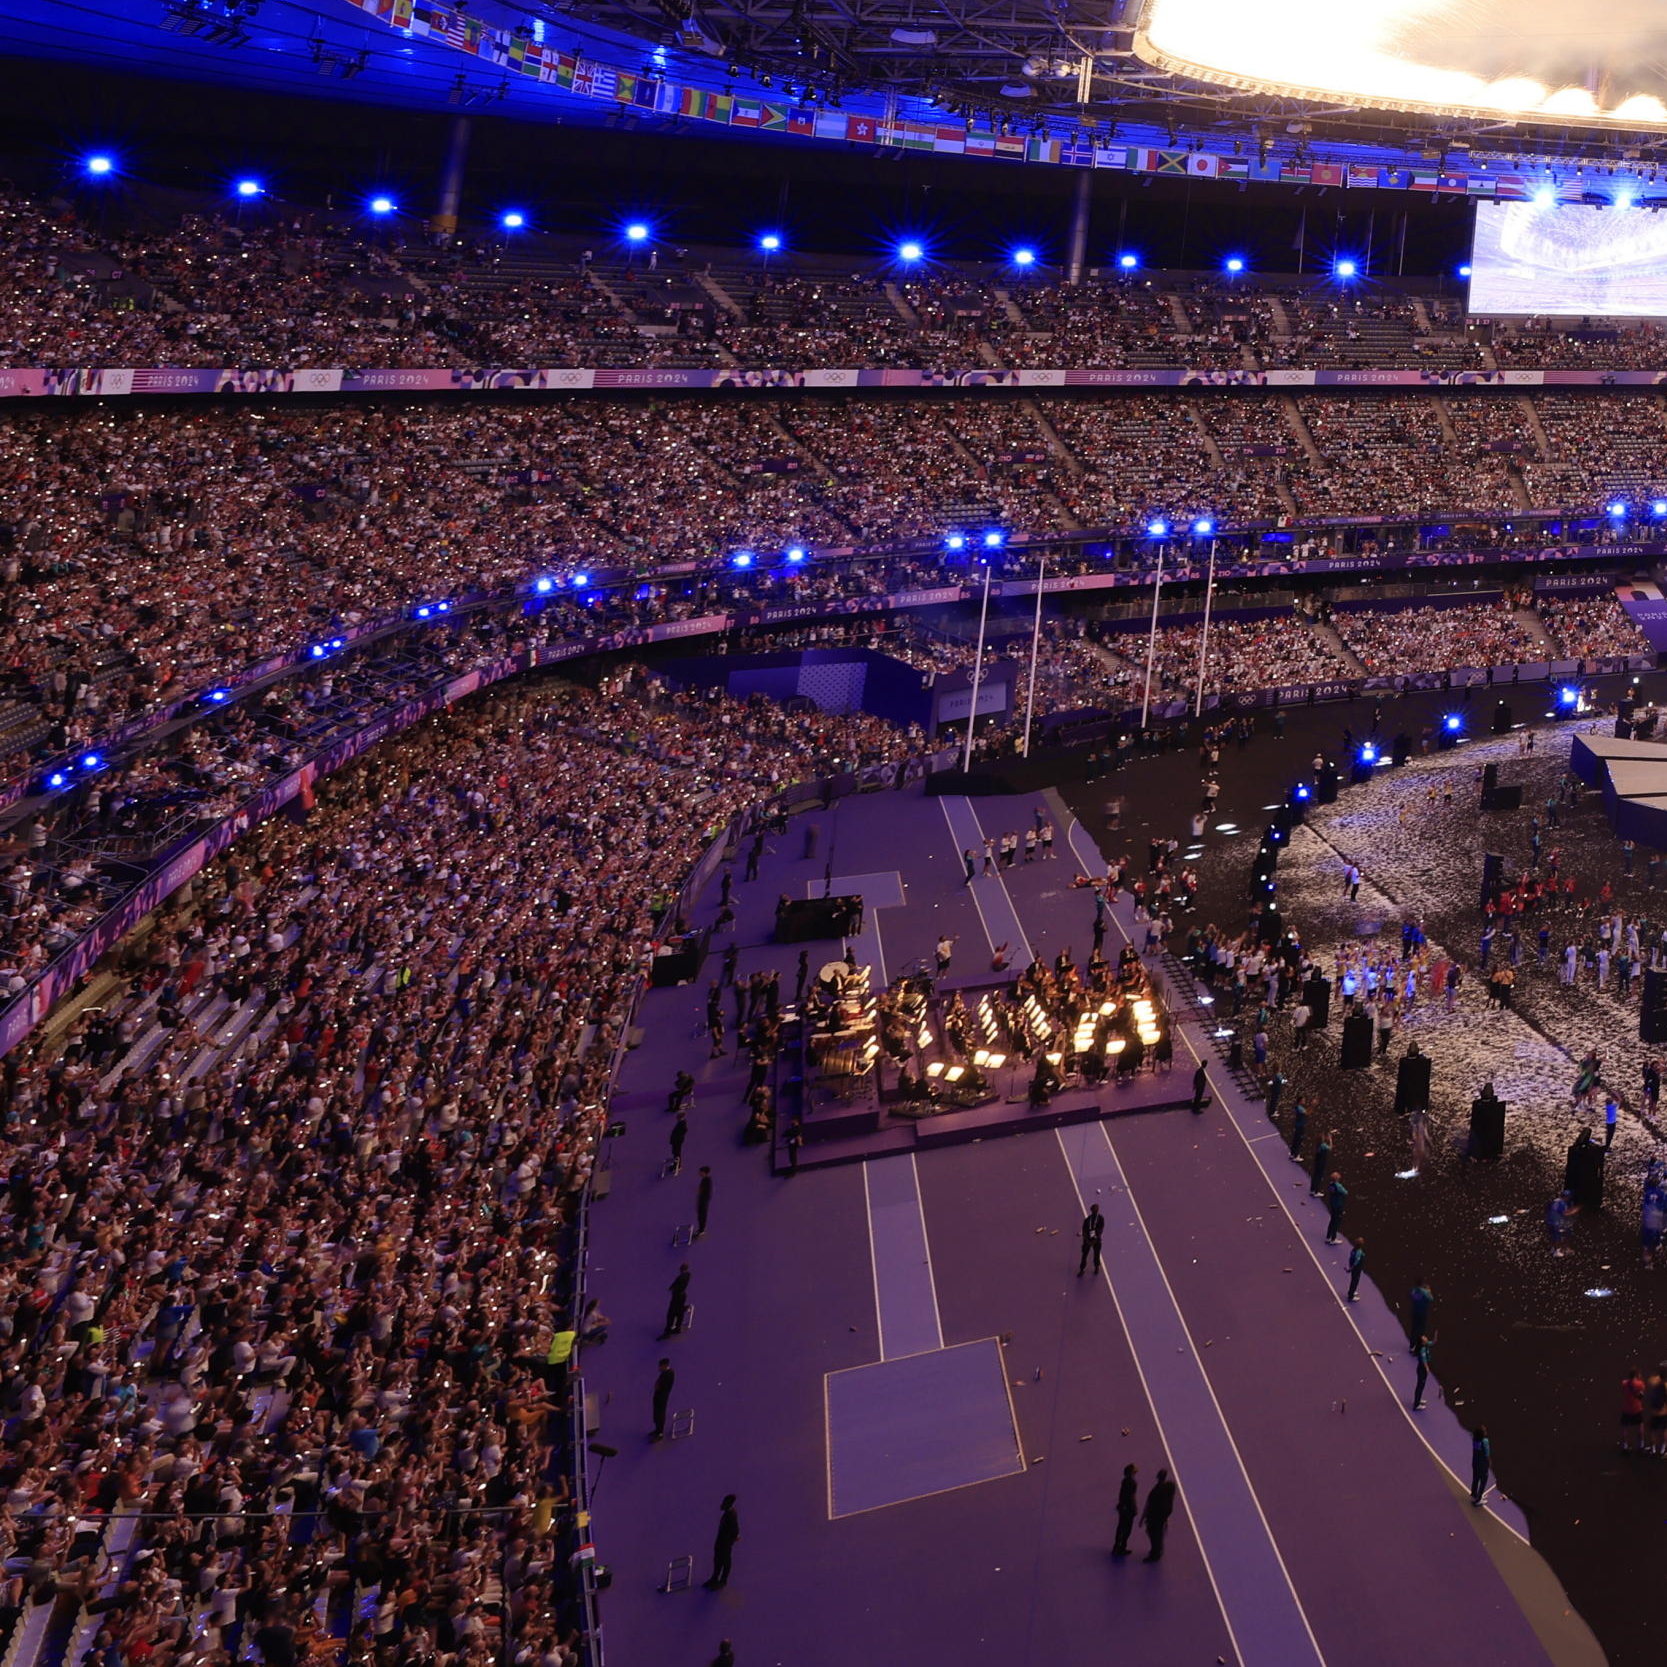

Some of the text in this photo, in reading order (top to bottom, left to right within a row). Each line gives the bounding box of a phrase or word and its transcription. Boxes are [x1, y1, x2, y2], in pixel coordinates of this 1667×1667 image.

[363, 375, 429, 386] PARIS 2024
[618, 374, 688, 384] PARIS 2024
[1089, 373, 1157, 382] PARIS 2024
[1337, 373, 1399, 382] PARIS 2024
[1596, 546, 1643, 555] PARIS 2024
[1329, 559, 1381, 569] PARIS 2024
[1546, 577, 1607, 587] PARIS 2024
[900, 591, 954, 604] PARIS 2024
[766, 606, 817, 620] PARIS 2024
